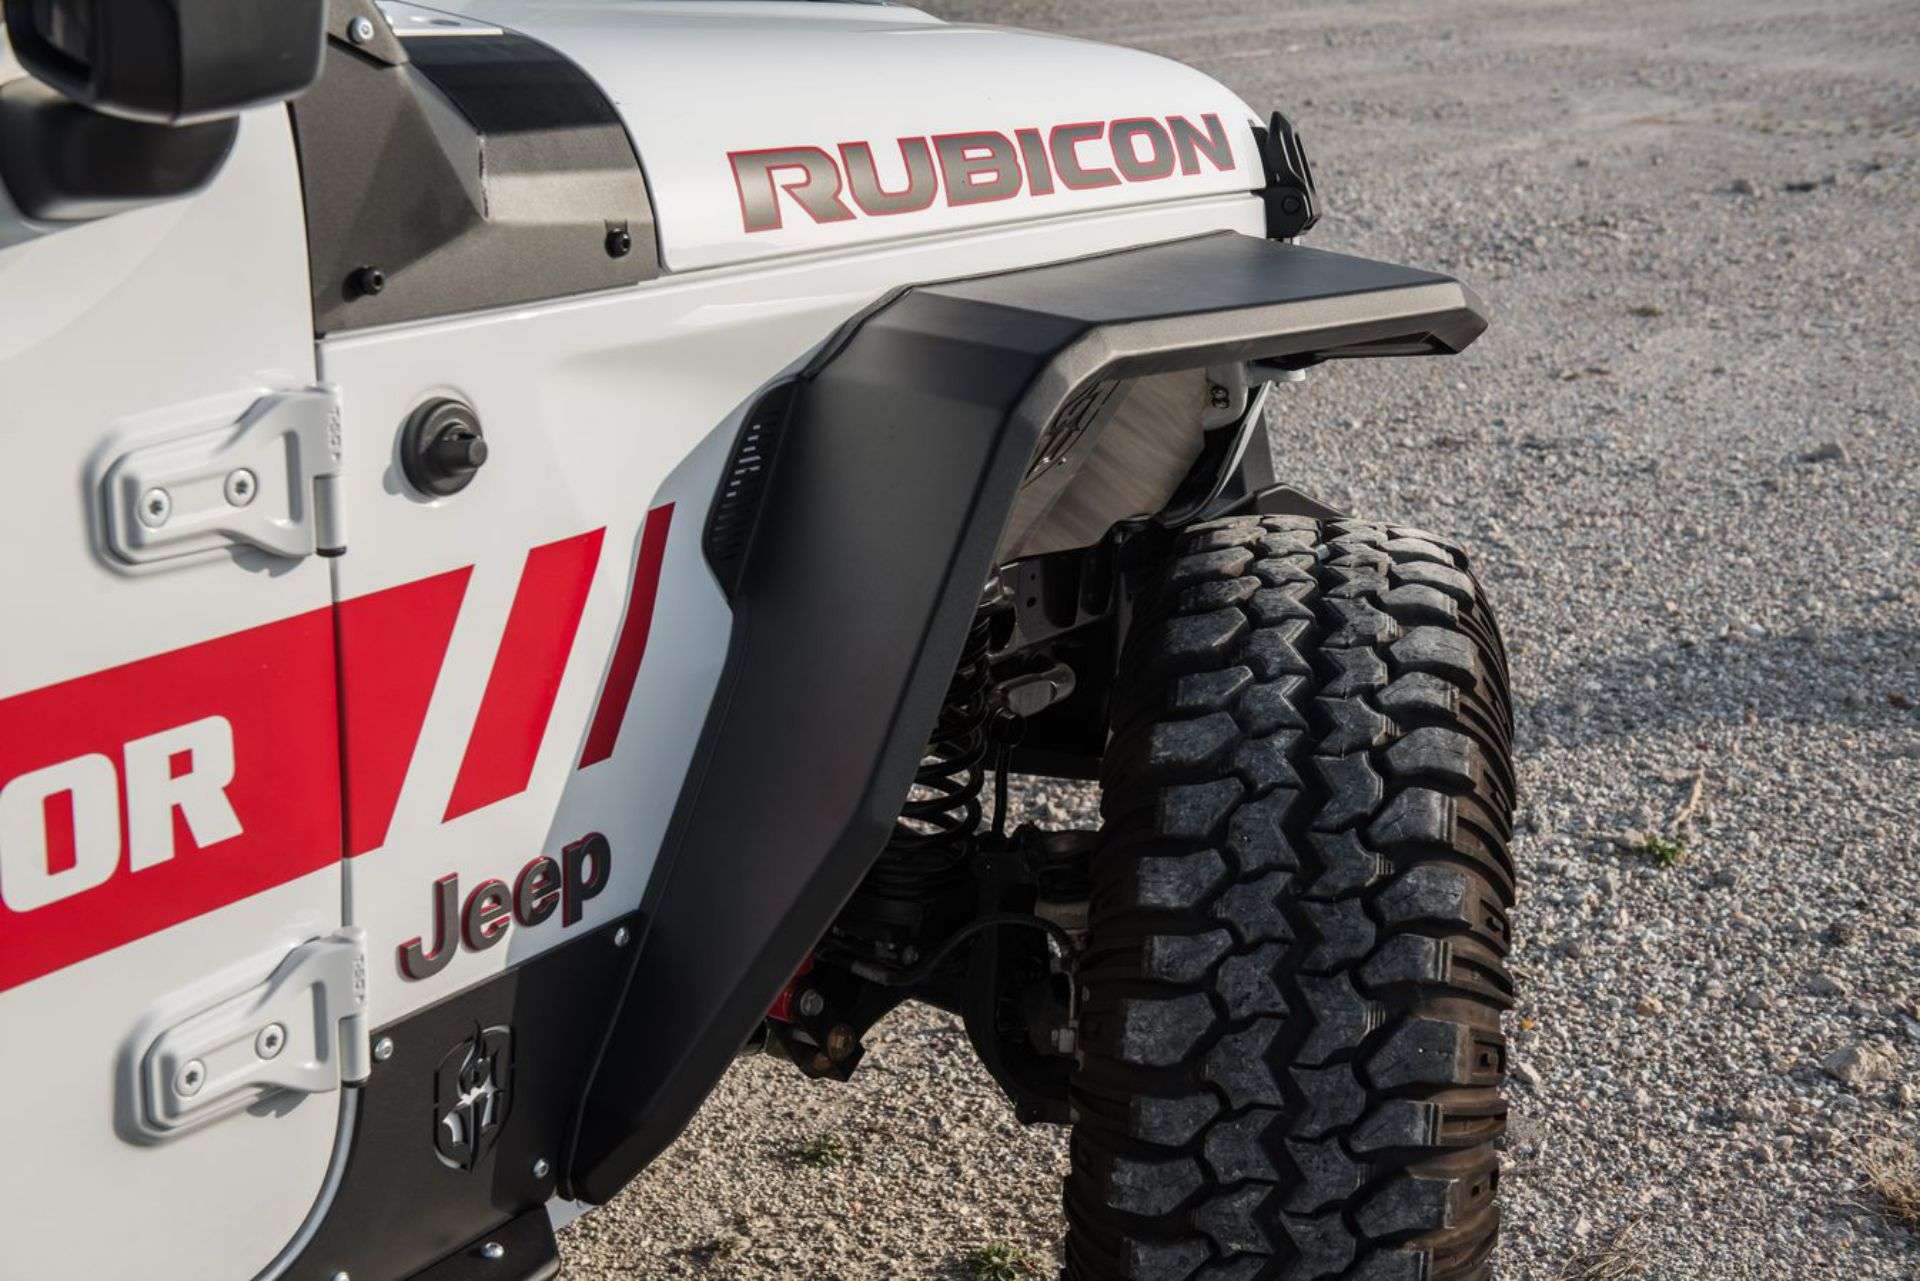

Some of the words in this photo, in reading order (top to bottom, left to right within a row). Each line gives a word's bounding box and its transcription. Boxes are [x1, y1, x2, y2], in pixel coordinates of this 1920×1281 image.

[726, 112, 1236, 233] RUBICON
[0, 715, 244, 913] OR
[396, 831, 611, 981] Jeep
